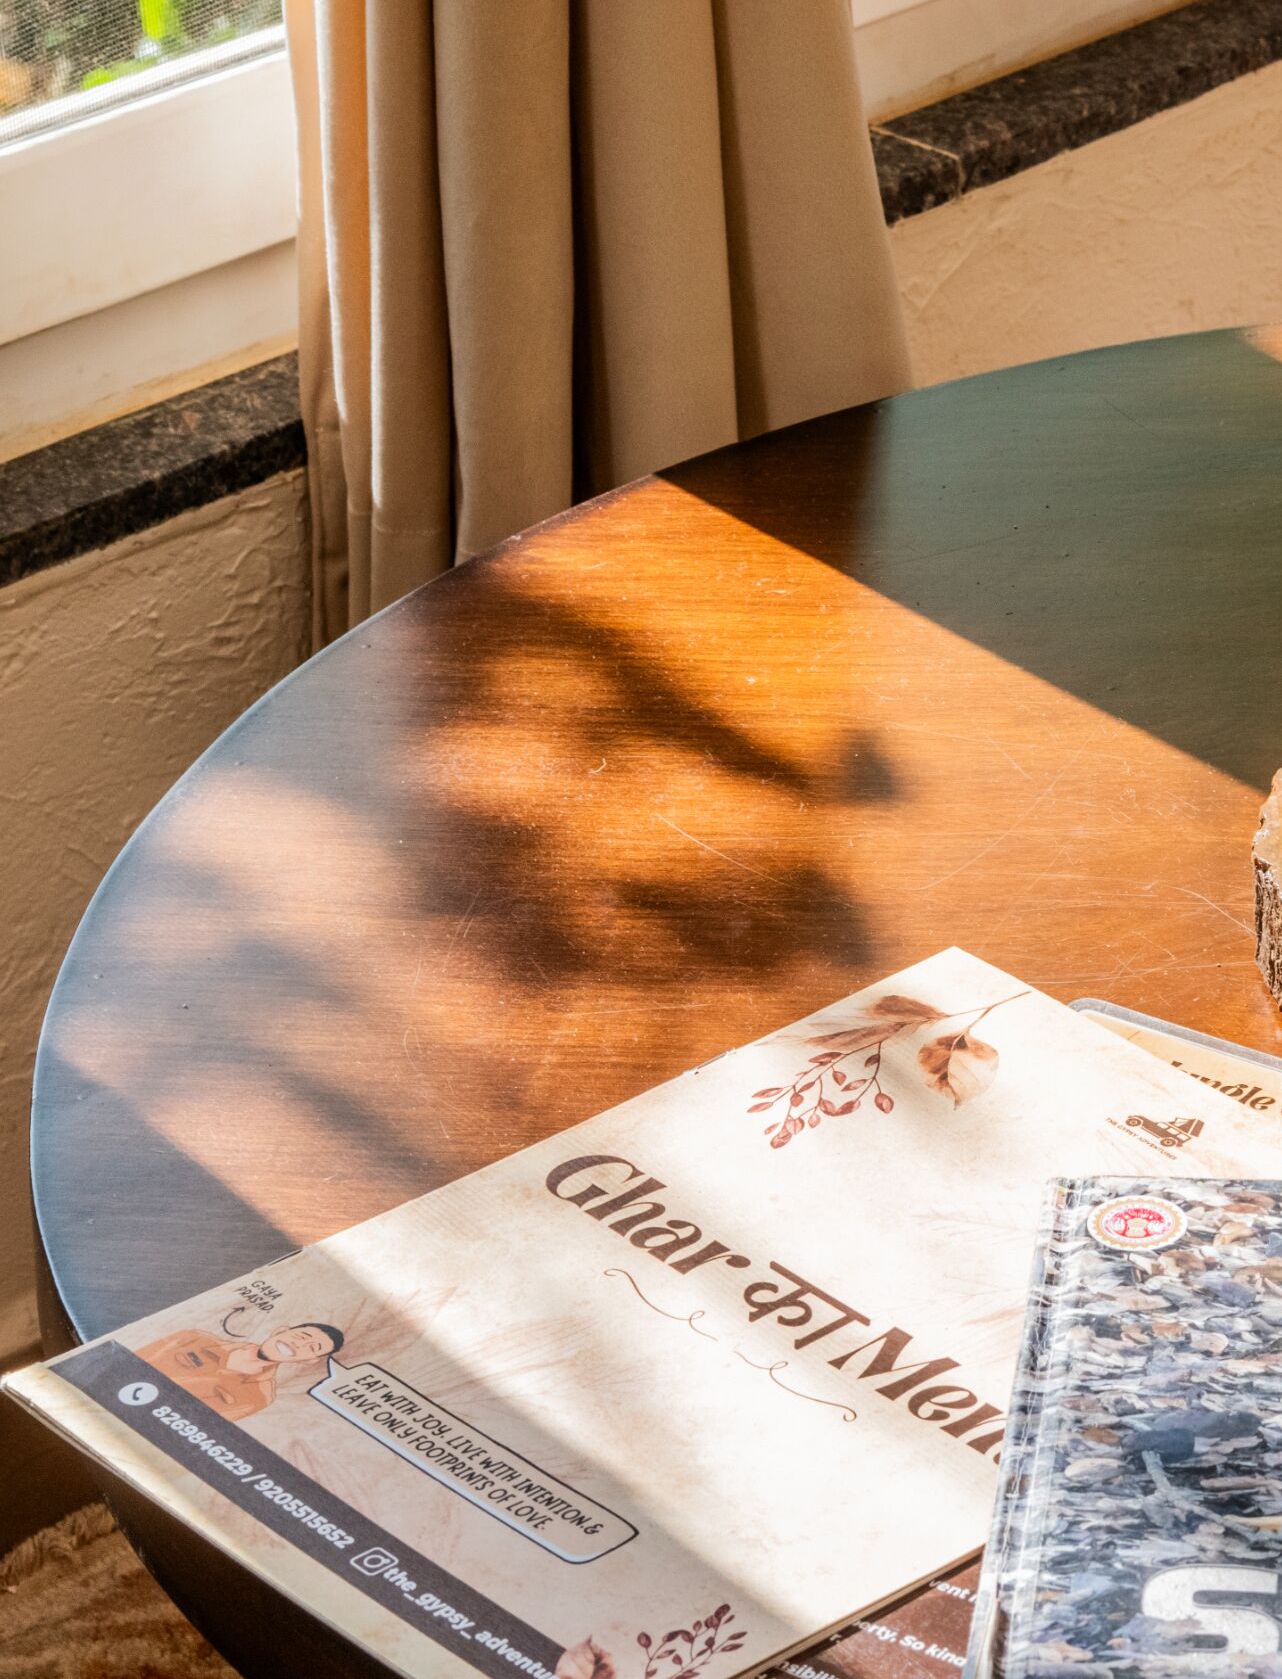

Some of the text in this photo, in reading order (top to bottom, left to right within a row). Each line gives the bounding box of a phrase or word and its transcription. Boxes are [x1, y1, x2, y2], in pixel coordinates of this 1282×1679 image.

[251, 1280, 283, 1301] GAYA
[545, 1154, 1010, 1466] Ghar का Men
[151, 1405, 254, 1476] 8269846229
[254, 1478, 355, 1550] 9205515652
[331, 1384, 555, 1531] LEAVE ONLY FOOTPRINTS OF LOVE.
[355, 1374, 386, 1393] EAT
[381, 1390, 421, 1416] WITH
[412, 1413, 450, 1439] JOY.
[446, 1435, 487, 1462] LIVE
[479, 1457, 522, 1483] WITH
[899, 1634, 926, 1651] So
